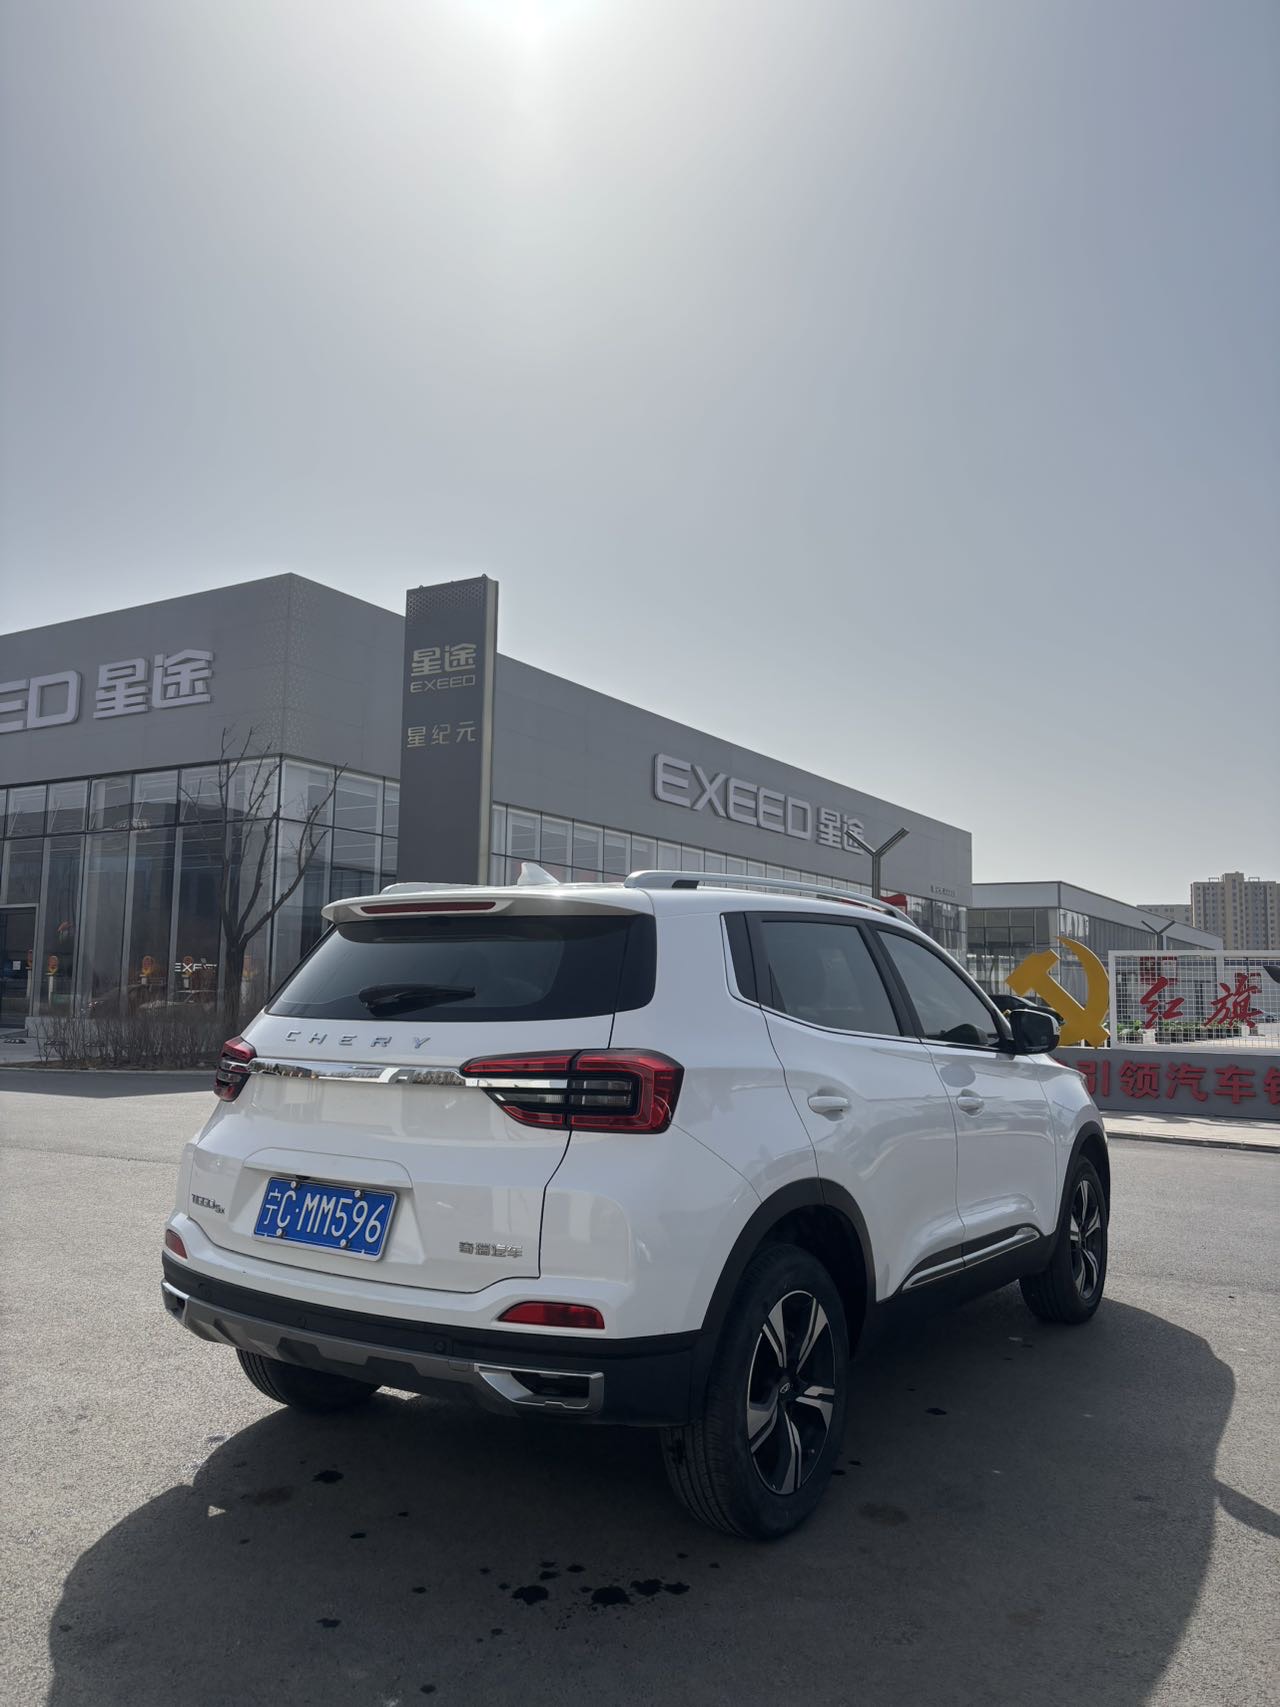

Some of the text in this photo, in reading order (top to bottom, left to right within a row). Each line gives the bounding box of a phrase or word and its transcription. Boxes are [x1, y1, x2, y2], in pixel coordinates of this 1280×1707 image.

[411, 643, 476, 676] 星途
[93, 648, 213, 719] 星途
[410, 675, 476, 693] EXEED
[407, 721, 476, 747] 星纪元
[655, 753, 865, 855] EXEED 星途
[1140, 975, 1263, 1029] 红旗
[285, 1030, 431, 1049] CHERY
[1056, 1059, 1280, 1105] 引领汽车
